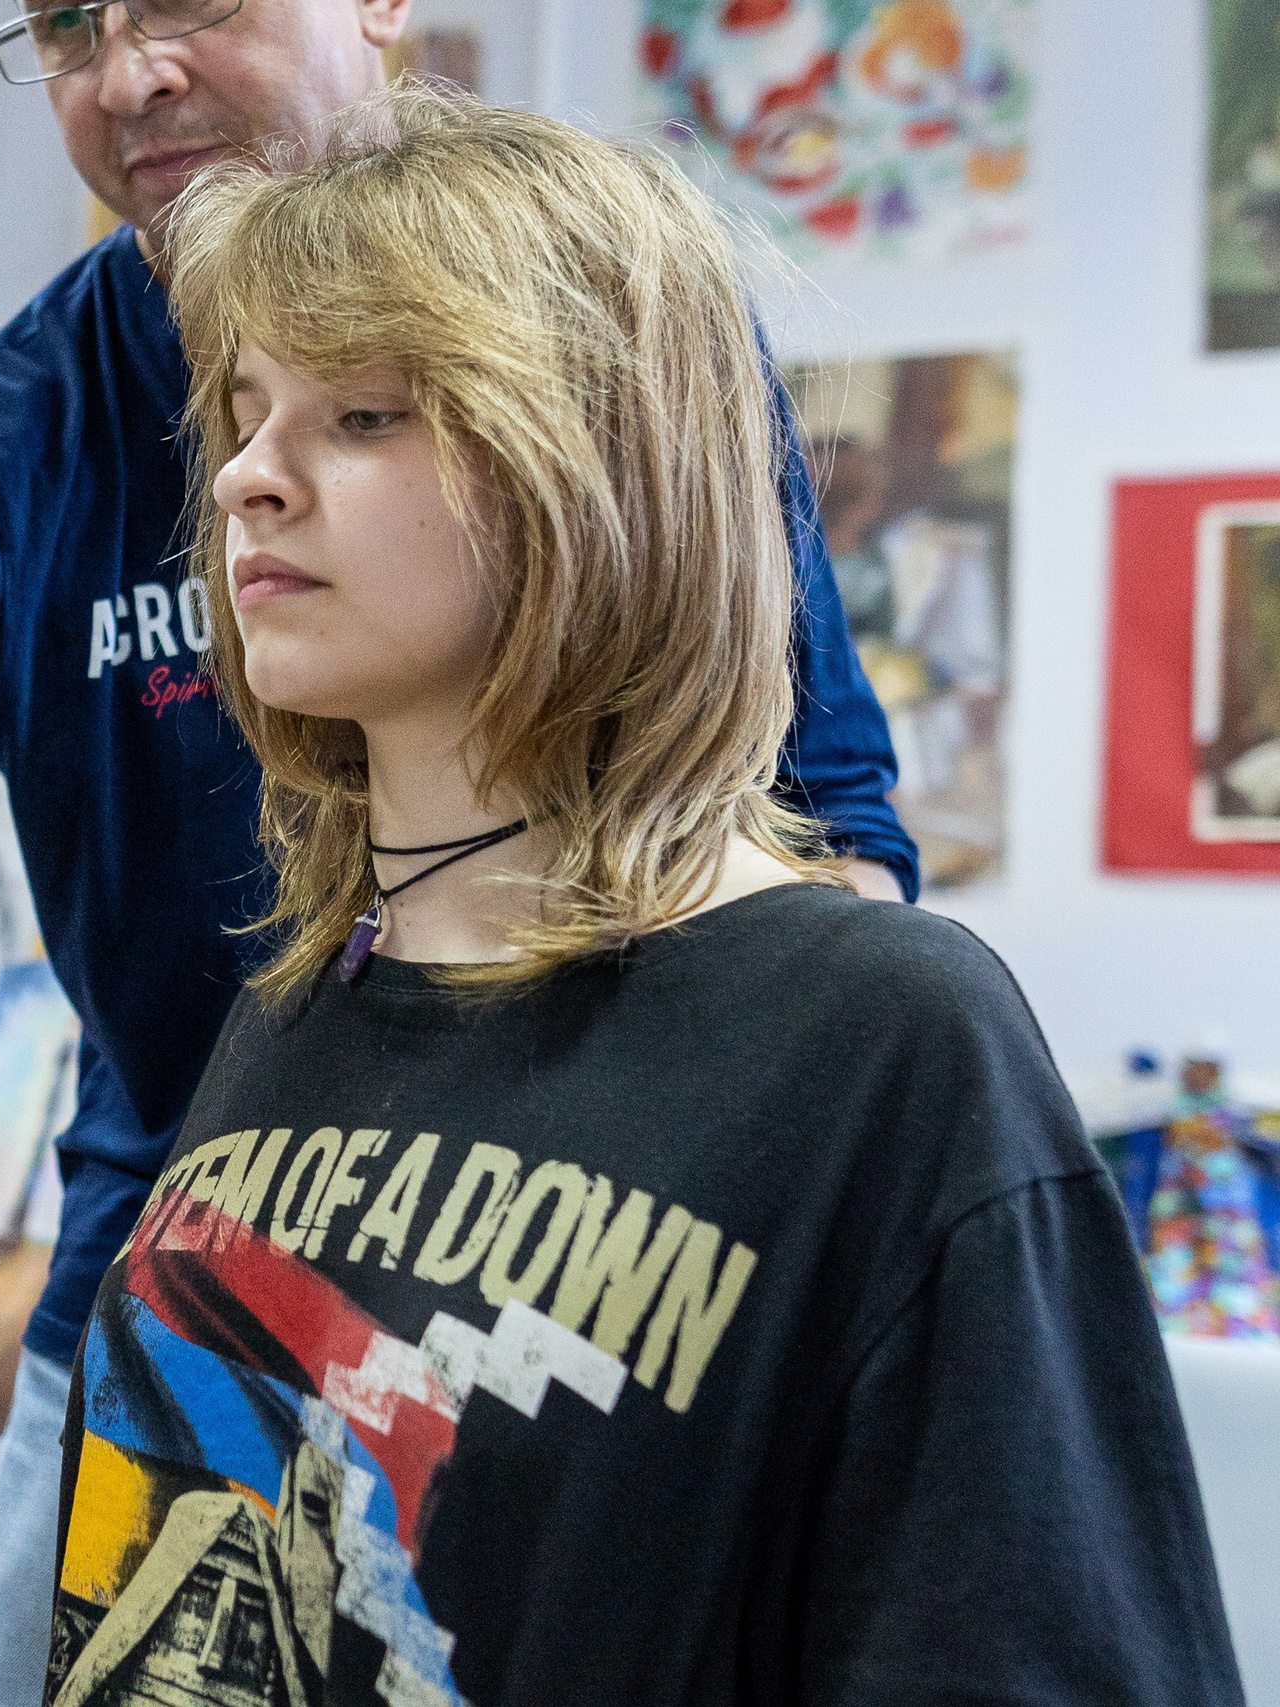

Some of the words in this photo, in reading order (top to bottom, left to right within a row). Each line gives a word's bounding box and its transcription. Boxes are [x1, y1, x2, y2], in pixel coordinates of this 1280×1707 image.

[270, 1127, 391, 1260] OF
[346, 1132, 441, 1271] A
[413, 1142, 758, 1413] DOWN
